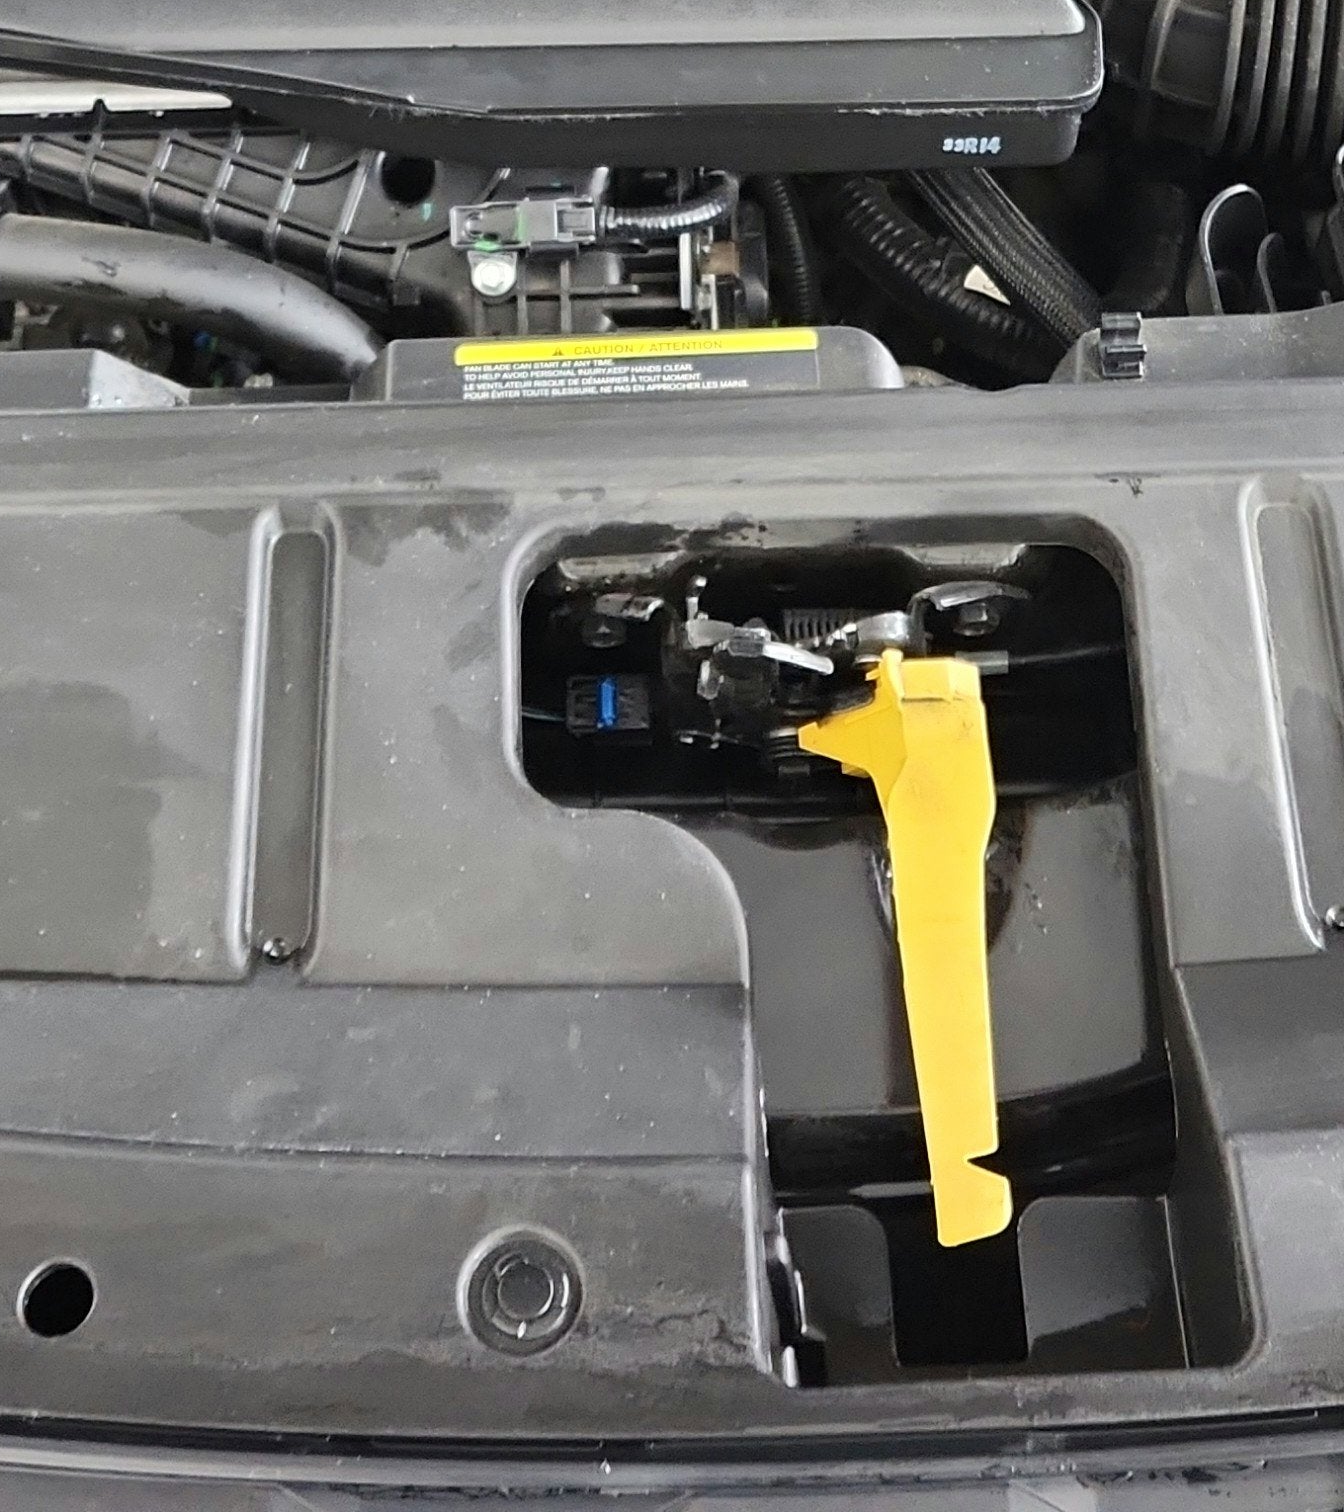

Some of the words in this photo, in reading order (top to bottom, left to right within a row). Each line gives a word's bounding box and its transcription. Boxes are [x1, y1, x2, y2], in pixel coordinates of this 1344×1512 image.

[574, 344, 634, 355] CAUTION
[649, 340, 723, 352] ATTENTION
[464, 373, 477, 381] TO
[478, 372, 501, 380] HELP
[502, 371, 528, 379] AVOID
[530, 369, 576, 378] PERSONAL
[630, 364, 662, 373] HANDS
[483, 363, 511, 371] BLADE
[513, 362, 531, 370] CAN
[533, 361, 560, 369] START
[562, 360, 573, 368] AT
[574, 359, 592, 367] ANY
[463, 391, 490, 400] POUR
[491, 389, 521, 399] ÉVITER
[522, 389, 550, 398] TOUTE
[600, 386, 613, 394] NE
[614, 384, 630, 393] PAS
[632, 384, 645, 392] EN
[646, 381, 701, 391] APPROCHER
[702, 380, 718, 389] LES
[464, 383, 475, 391] LE
[476, 380, 532, 390] VENTILATEUR
[534, 378, 566, 387] RISQUE
[568, 377, 580, 385] DE
[582, 374, 629, 385] DÉMARRER
[639, 374, 661, 382] TOUT
